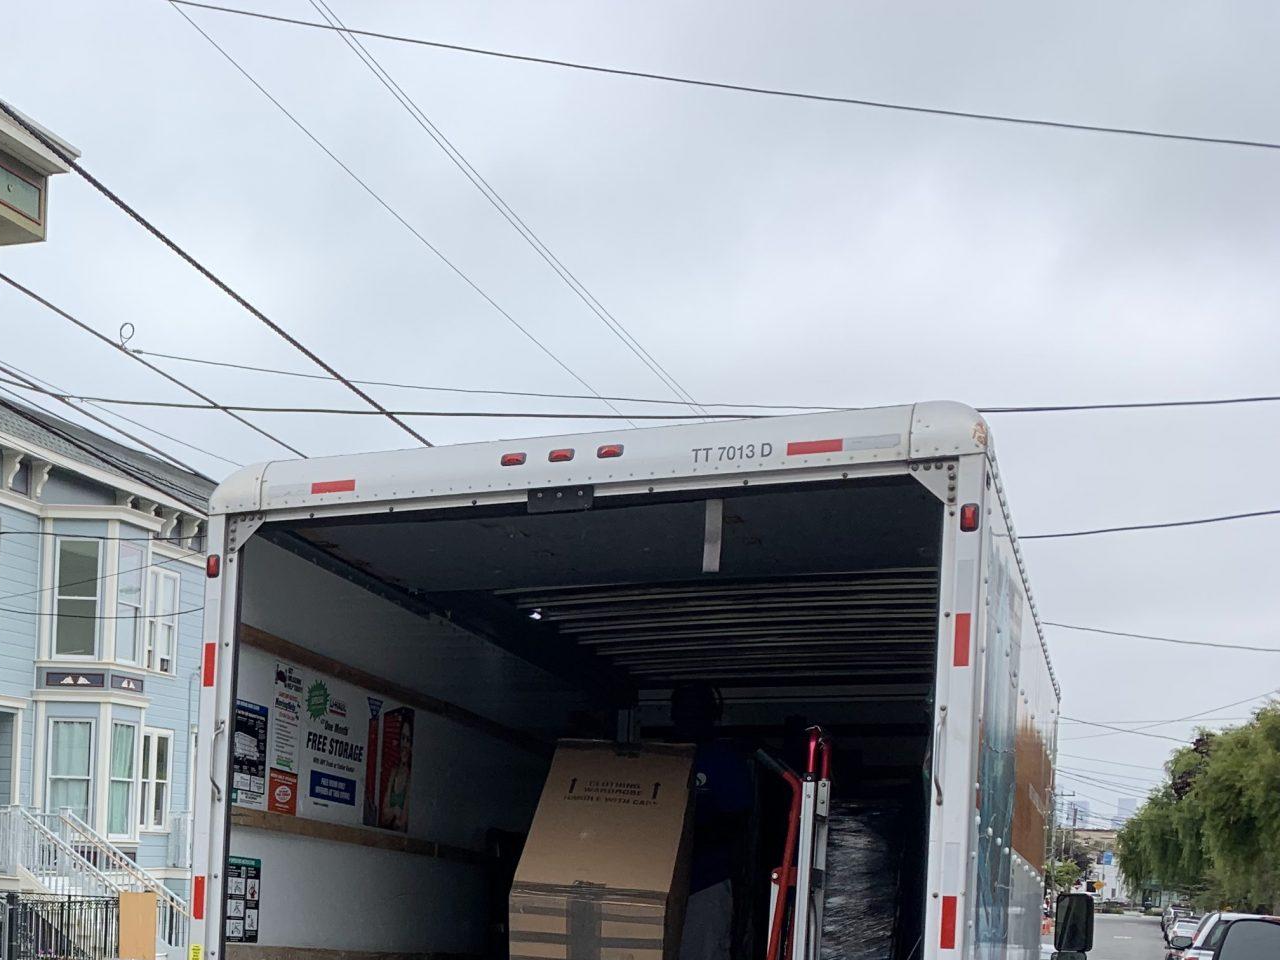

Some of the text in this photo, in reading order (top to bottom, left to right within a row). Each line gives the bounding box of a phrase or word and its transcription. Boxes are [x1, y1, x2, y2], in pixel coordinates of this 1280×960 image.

[692, 443, 773, 463] TT 7013 D
[306, 731, 328, 753] FREE
[329, 738, 363, 763] STORAGE
[584, 787, 642, 796] WARDROBE
[589, 780, 640, 789] CLOTHING
